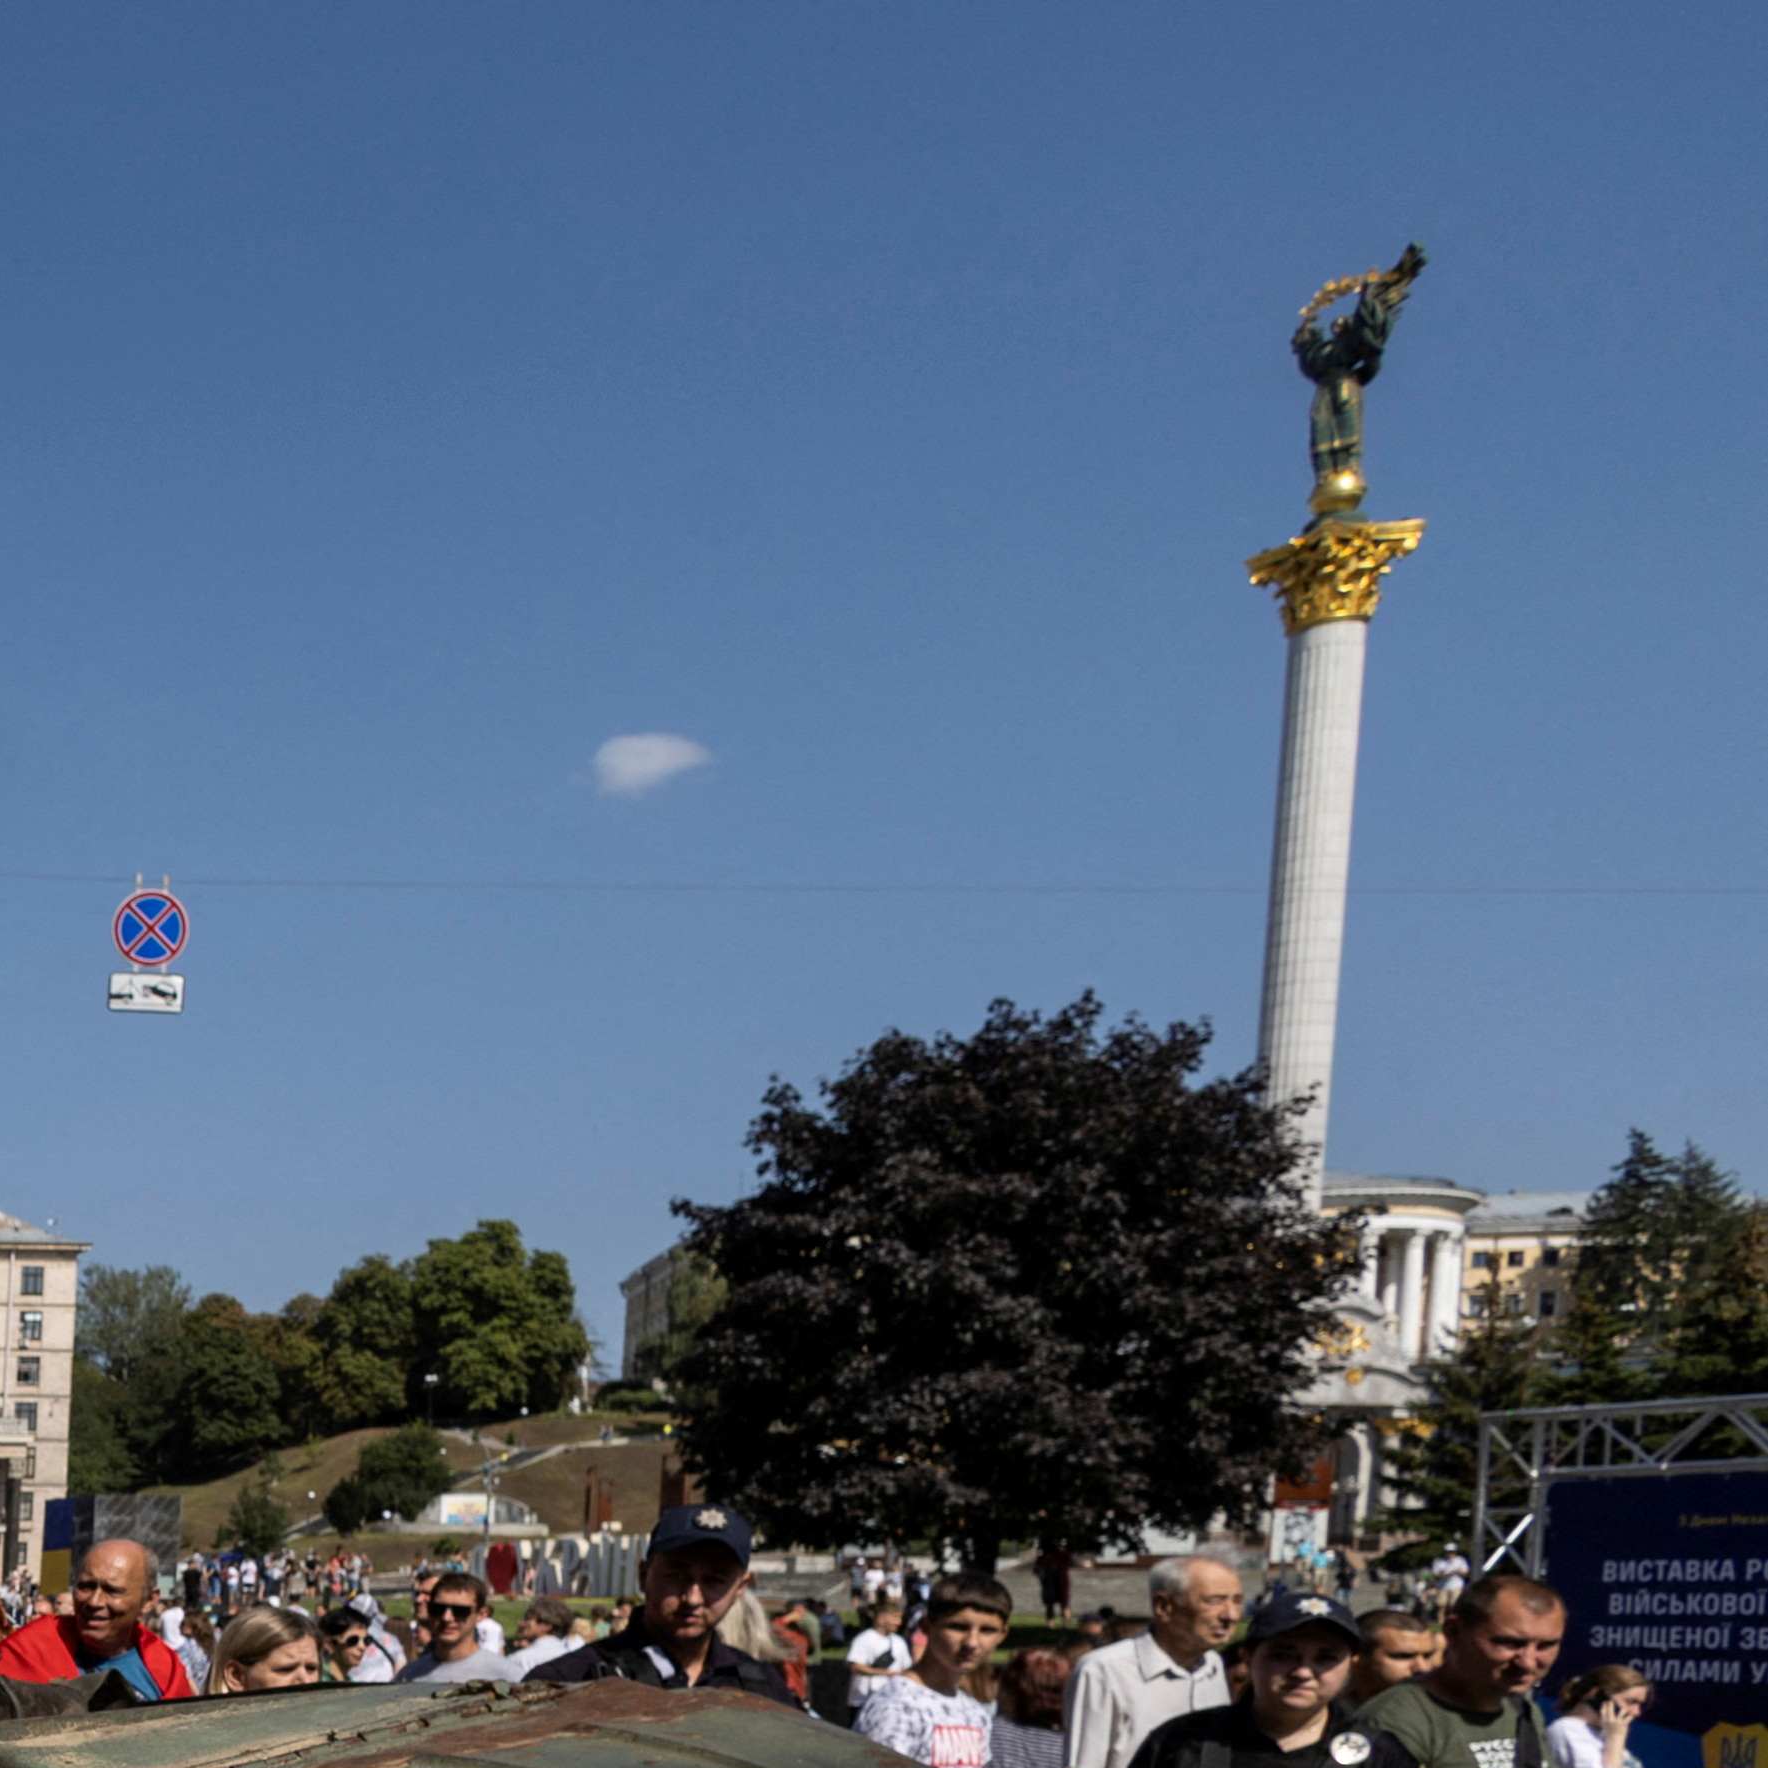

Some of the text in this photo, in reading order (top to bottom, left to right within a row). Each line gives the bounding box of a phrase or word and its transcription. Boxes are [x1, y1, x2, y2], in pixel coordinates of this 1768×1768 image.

[1602, 1559, 1736, 1582] ВИСТАВКА
[1608, 1588, 1767, 1616] ВІЙСЬКОВОЇ
[1589, 1621, 1733, 1652] ЗНИЩЕНОЇ
